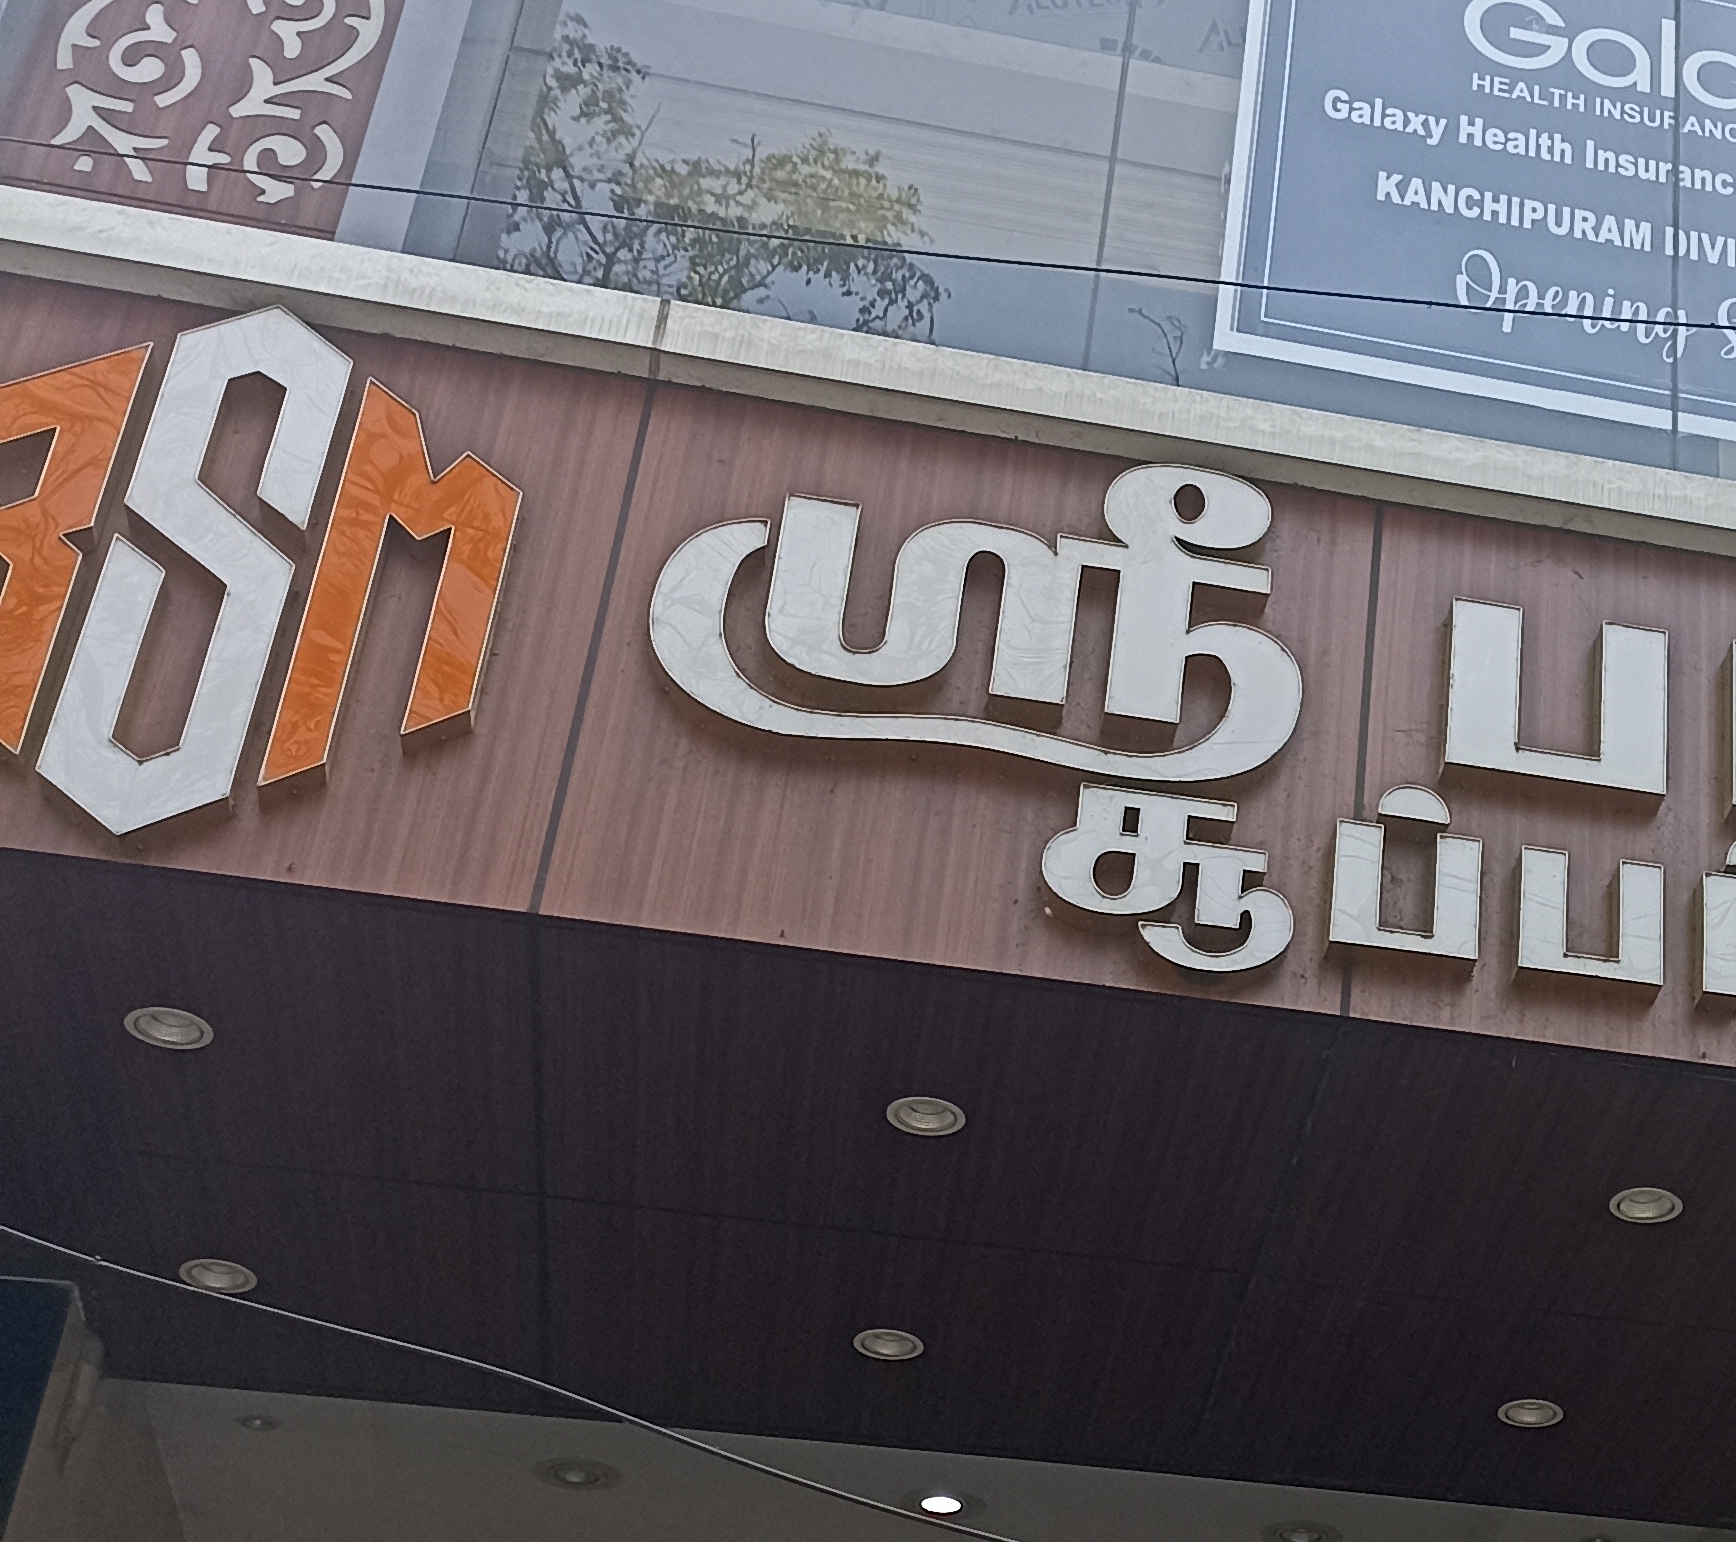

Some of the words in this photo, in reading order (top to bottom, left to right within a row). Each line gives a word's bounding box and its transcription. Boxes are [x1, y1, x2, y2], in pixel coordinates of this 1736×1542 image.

[1323, 88, 1448, 147] Galaxy
[1458, 114, 1573, 165] Health
[1471, 72, 1586, 113] HEALTH
[1376, 170, 1653, 252] KANCHIPURAM
[1455, 248, 1698, 364] Opening
